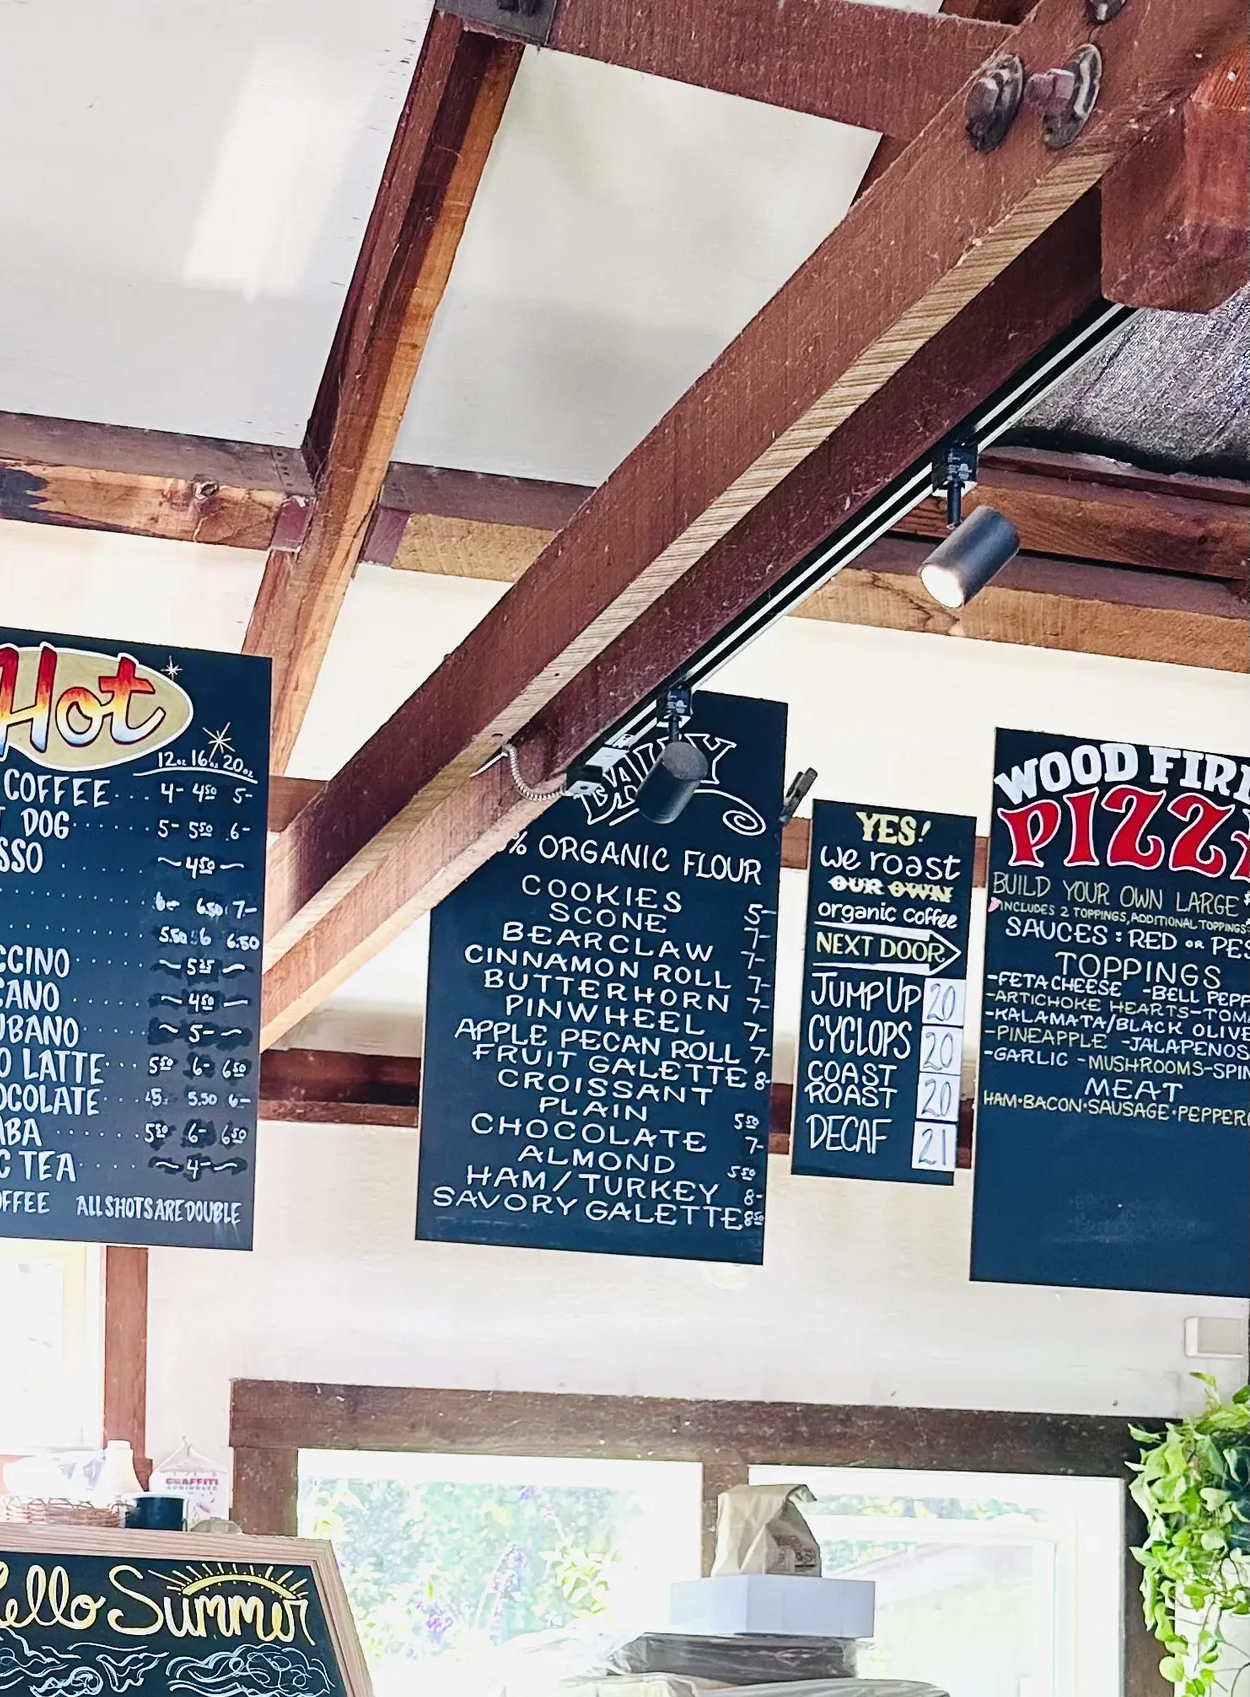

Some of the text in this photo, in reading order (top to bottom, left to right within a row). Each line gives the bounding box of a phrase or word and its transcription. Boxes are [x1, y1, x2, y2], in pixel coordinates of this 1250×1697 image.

[3, 768, 110, 808] COFFEE
[994, 742, 1139, 805] WOOD
[21, 808, 70, 839] DOG
[856, 811, 932, 847] YES!
[539, 834, 762, 885] ORGANIC FLOUR
[870, 851, 961, 881] roast
[522, 874, 682, 913] COOKIES
[993, 871, 1239, 917] BUILD YOUR OWN LARGE
[549, 902, 667, 933] SCONE
[818, 901, 958, 929] organic coffee
[815, 932, 946, 963] NEXT DOOR
[1128, 929, 1205, 951] RED OR
[464, 944, 732, 989] CINNAMON ROLL
[1055, 952, 1221, 989] TOPPINGS
[484, 969, 729, 1012] BUTTERHORN
[505, 995, 705, 1036] PINWHEEL
[808, 1015, 953, 1070] CYCLOPS 20
[472, 1043, 748, 1089] FRUIT GALETTE
[807, 1061, 897, 1087] COAST
[498, 1069, 713, 1106] CROISSANT
[805, 1079, 952, 1118] ROAST 20
[1084, 1078, 1183, 1102] MEAT
[539, 1097, 648, 1122] PLAIN
[471, 1113, 706, 1152] CHOCOLATE
[806, 1114, 947, 1167] DECAF 21
[19, 1151, 76, 1182] TEA
[517, 1145, 676, 1174] ALMOND
